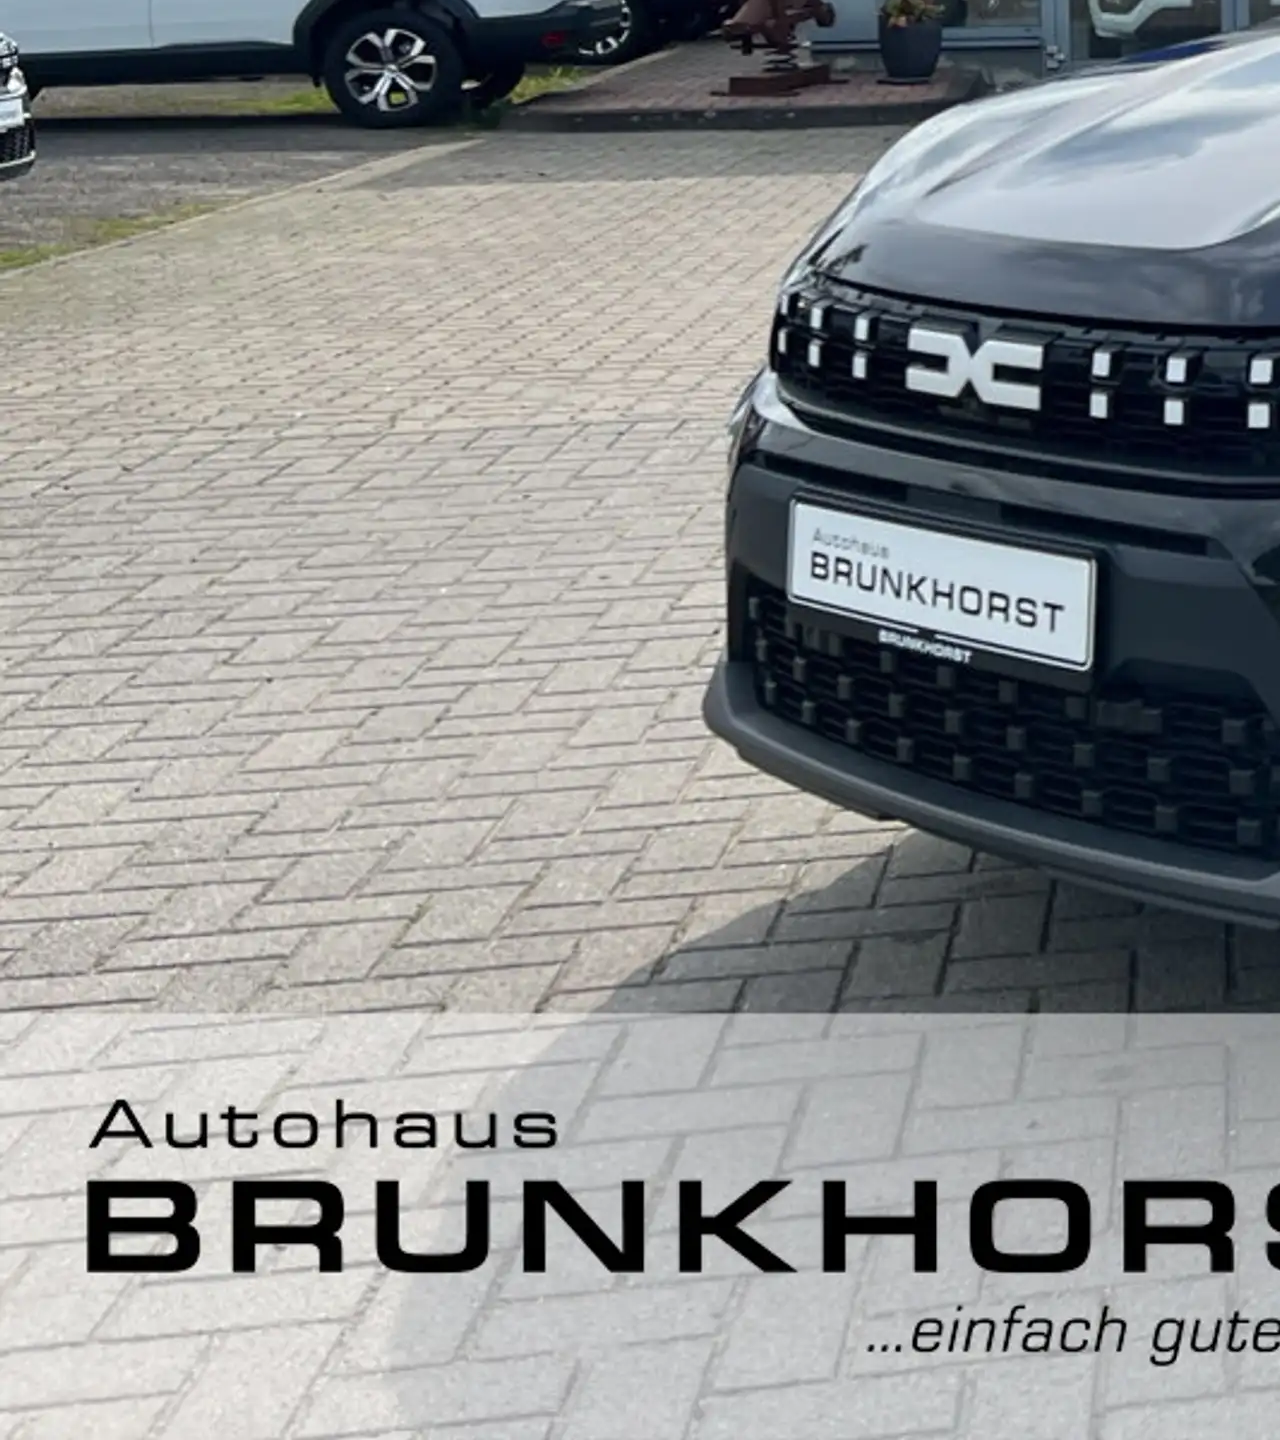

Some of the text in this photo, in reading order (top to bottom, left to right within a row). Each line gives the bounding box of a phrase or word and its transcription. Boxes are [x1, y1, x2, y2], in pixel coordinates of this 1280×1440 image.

[812, 526, 891, 560] Autohaus
[810, 550, 1066, 633] BRUNKHORST
[878, 628, 974, 664] BRUNKHORST
